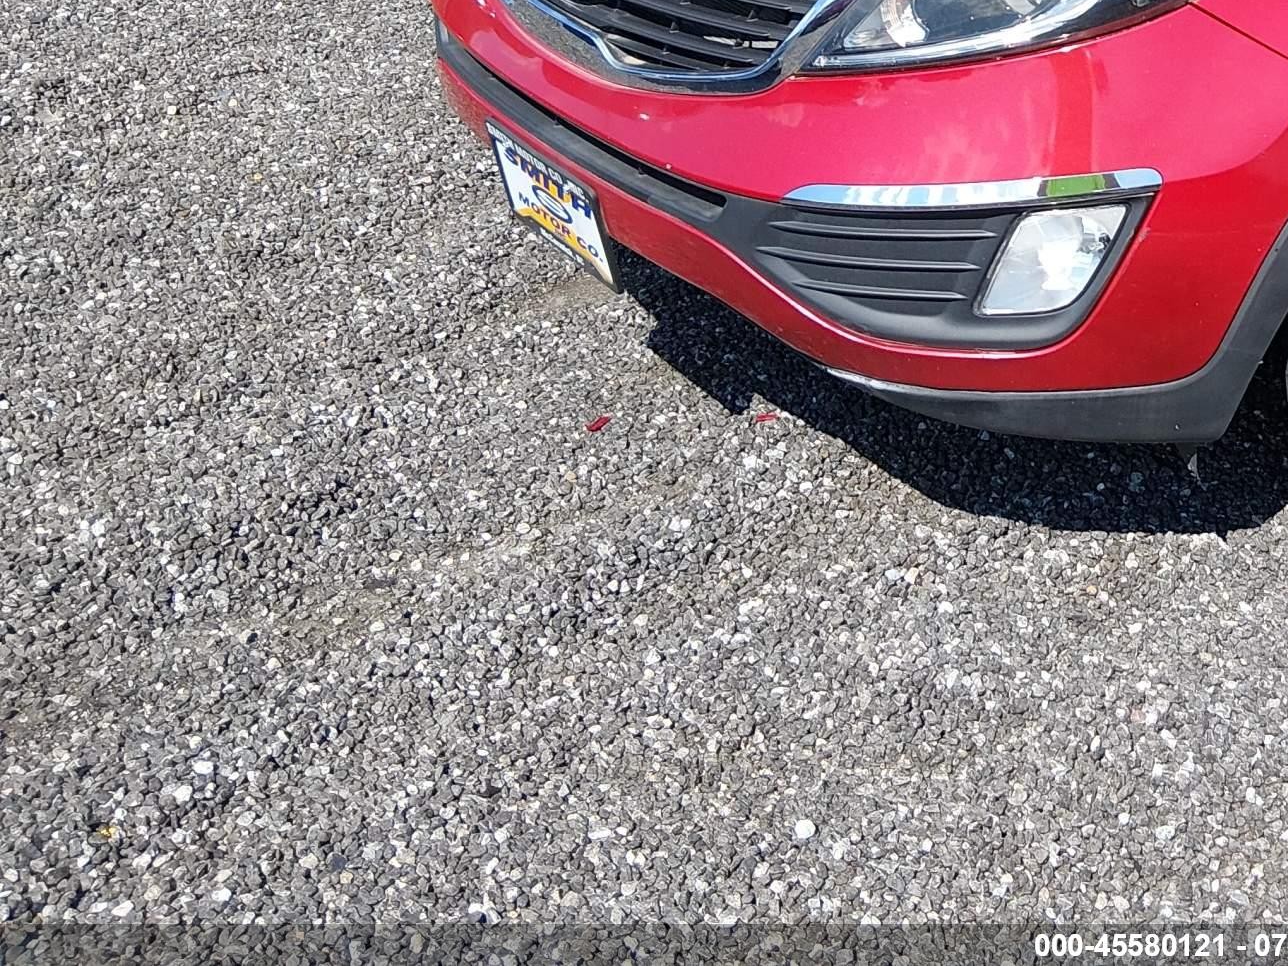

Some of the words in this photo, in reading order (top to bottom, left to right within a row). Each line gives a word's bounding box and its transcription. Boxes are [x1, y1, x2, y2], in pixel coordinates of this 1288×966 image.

[504, 147, 592, 220] SMITH
[518, 191, 571, 240] MOTOR
[577, 236, 604, 263] CO.
